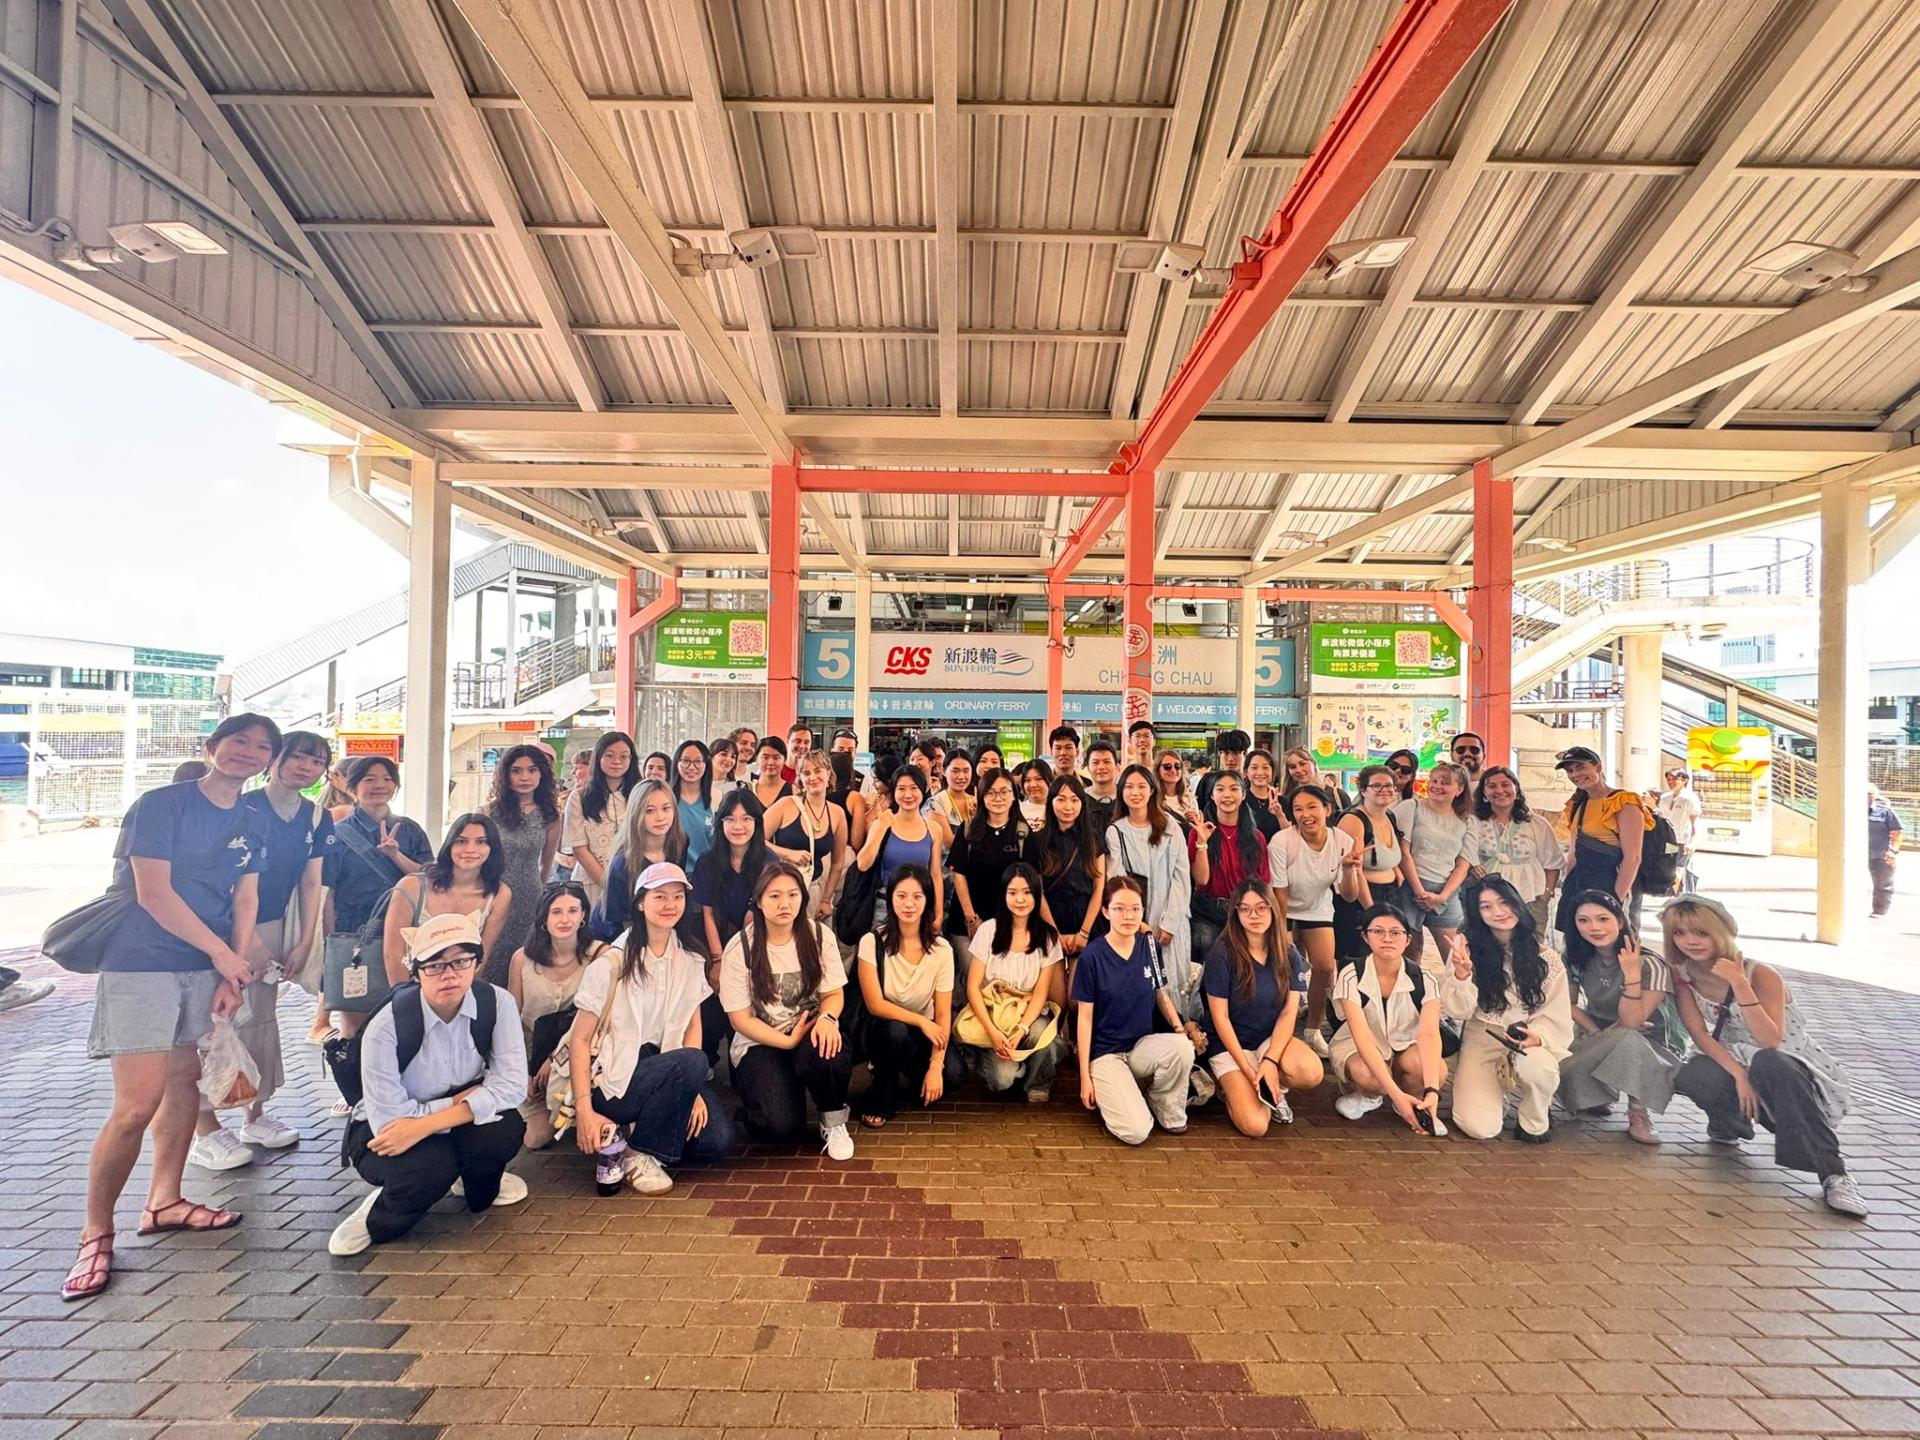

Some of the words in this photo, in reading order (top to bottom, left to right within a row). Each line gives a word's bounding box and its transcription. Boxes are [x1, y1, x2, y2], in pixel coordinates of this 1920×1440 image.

[817, 638, 850, 680] 5
[886, 646, 932, 668] CKS
[944, 647, 998, 665] 新渡輪
[1152, 645, 1177, 666] 洲
[944, 665, 963, 673] SUN
[965, 665, 997, 673] FERRY
[1255, 646, 1282, 687] 5
[1170, 671, 1213, 686] CHAU
[944, 701, 996, 711] ORDINARY
[997, 701, 1031, 711] FERRY
[1094, 703, 1120, 713] FAST
[1166, 704, 1216, 715] WELCOME
[1218, 705, 1232, 715] TO
